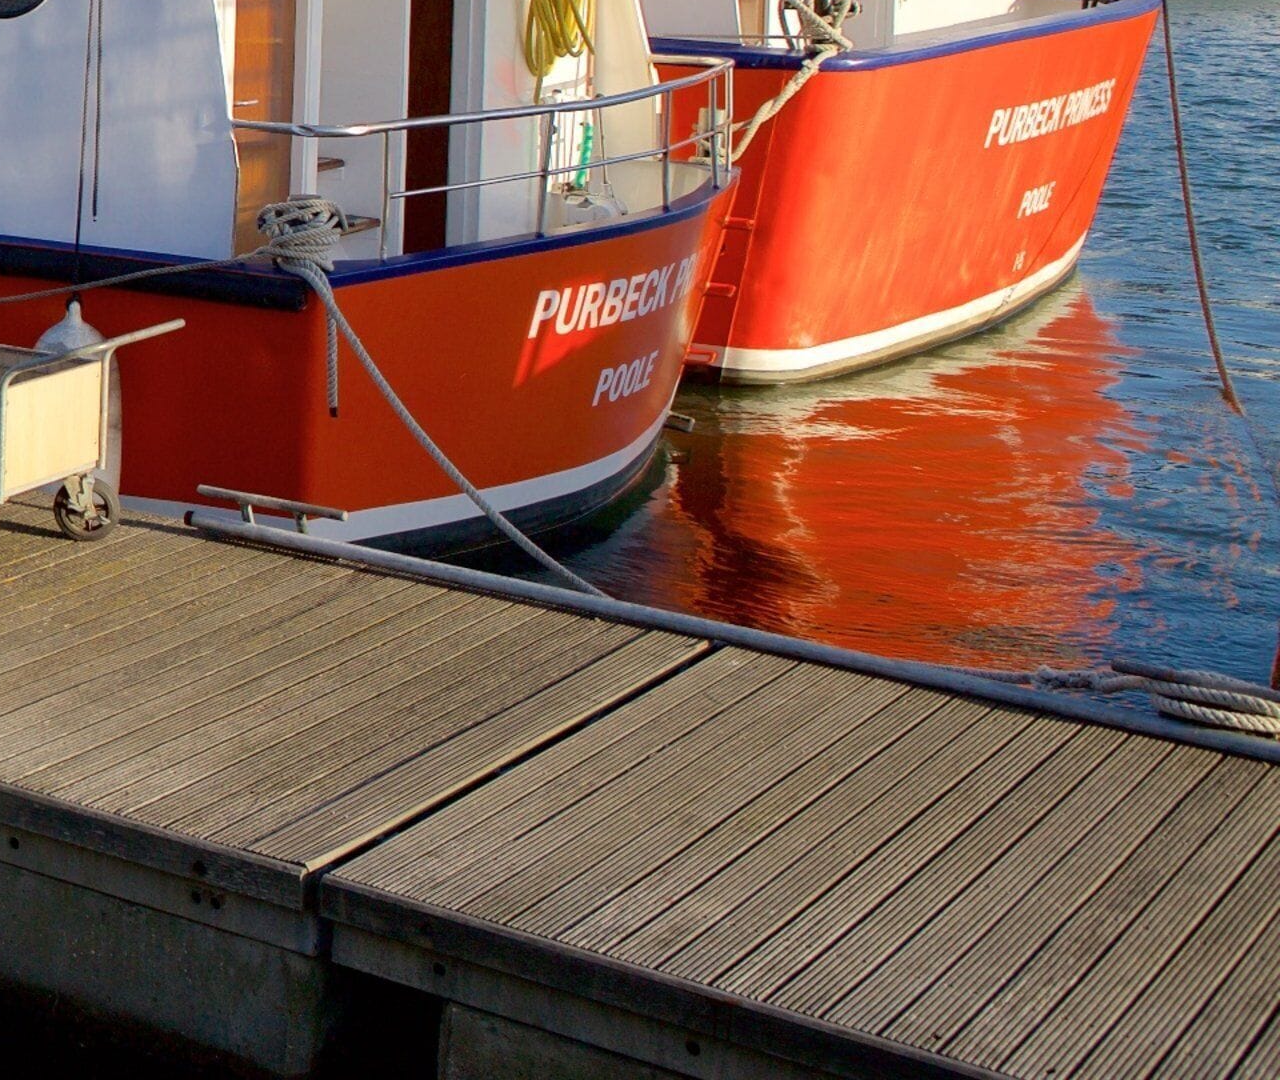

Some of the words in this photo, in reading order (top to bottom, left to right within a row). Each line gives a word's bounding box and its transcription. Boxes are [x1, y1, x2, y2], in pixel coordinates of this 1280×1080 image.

[983, 94, 1068, 149] PURBECK
[1060, 78, 1117, 130] PRINCESS
[1016, 181, 1057, 219] POOLE
[527, 262, 676, 340] PURBECK
[591, 349, 659, 408] POOLE
